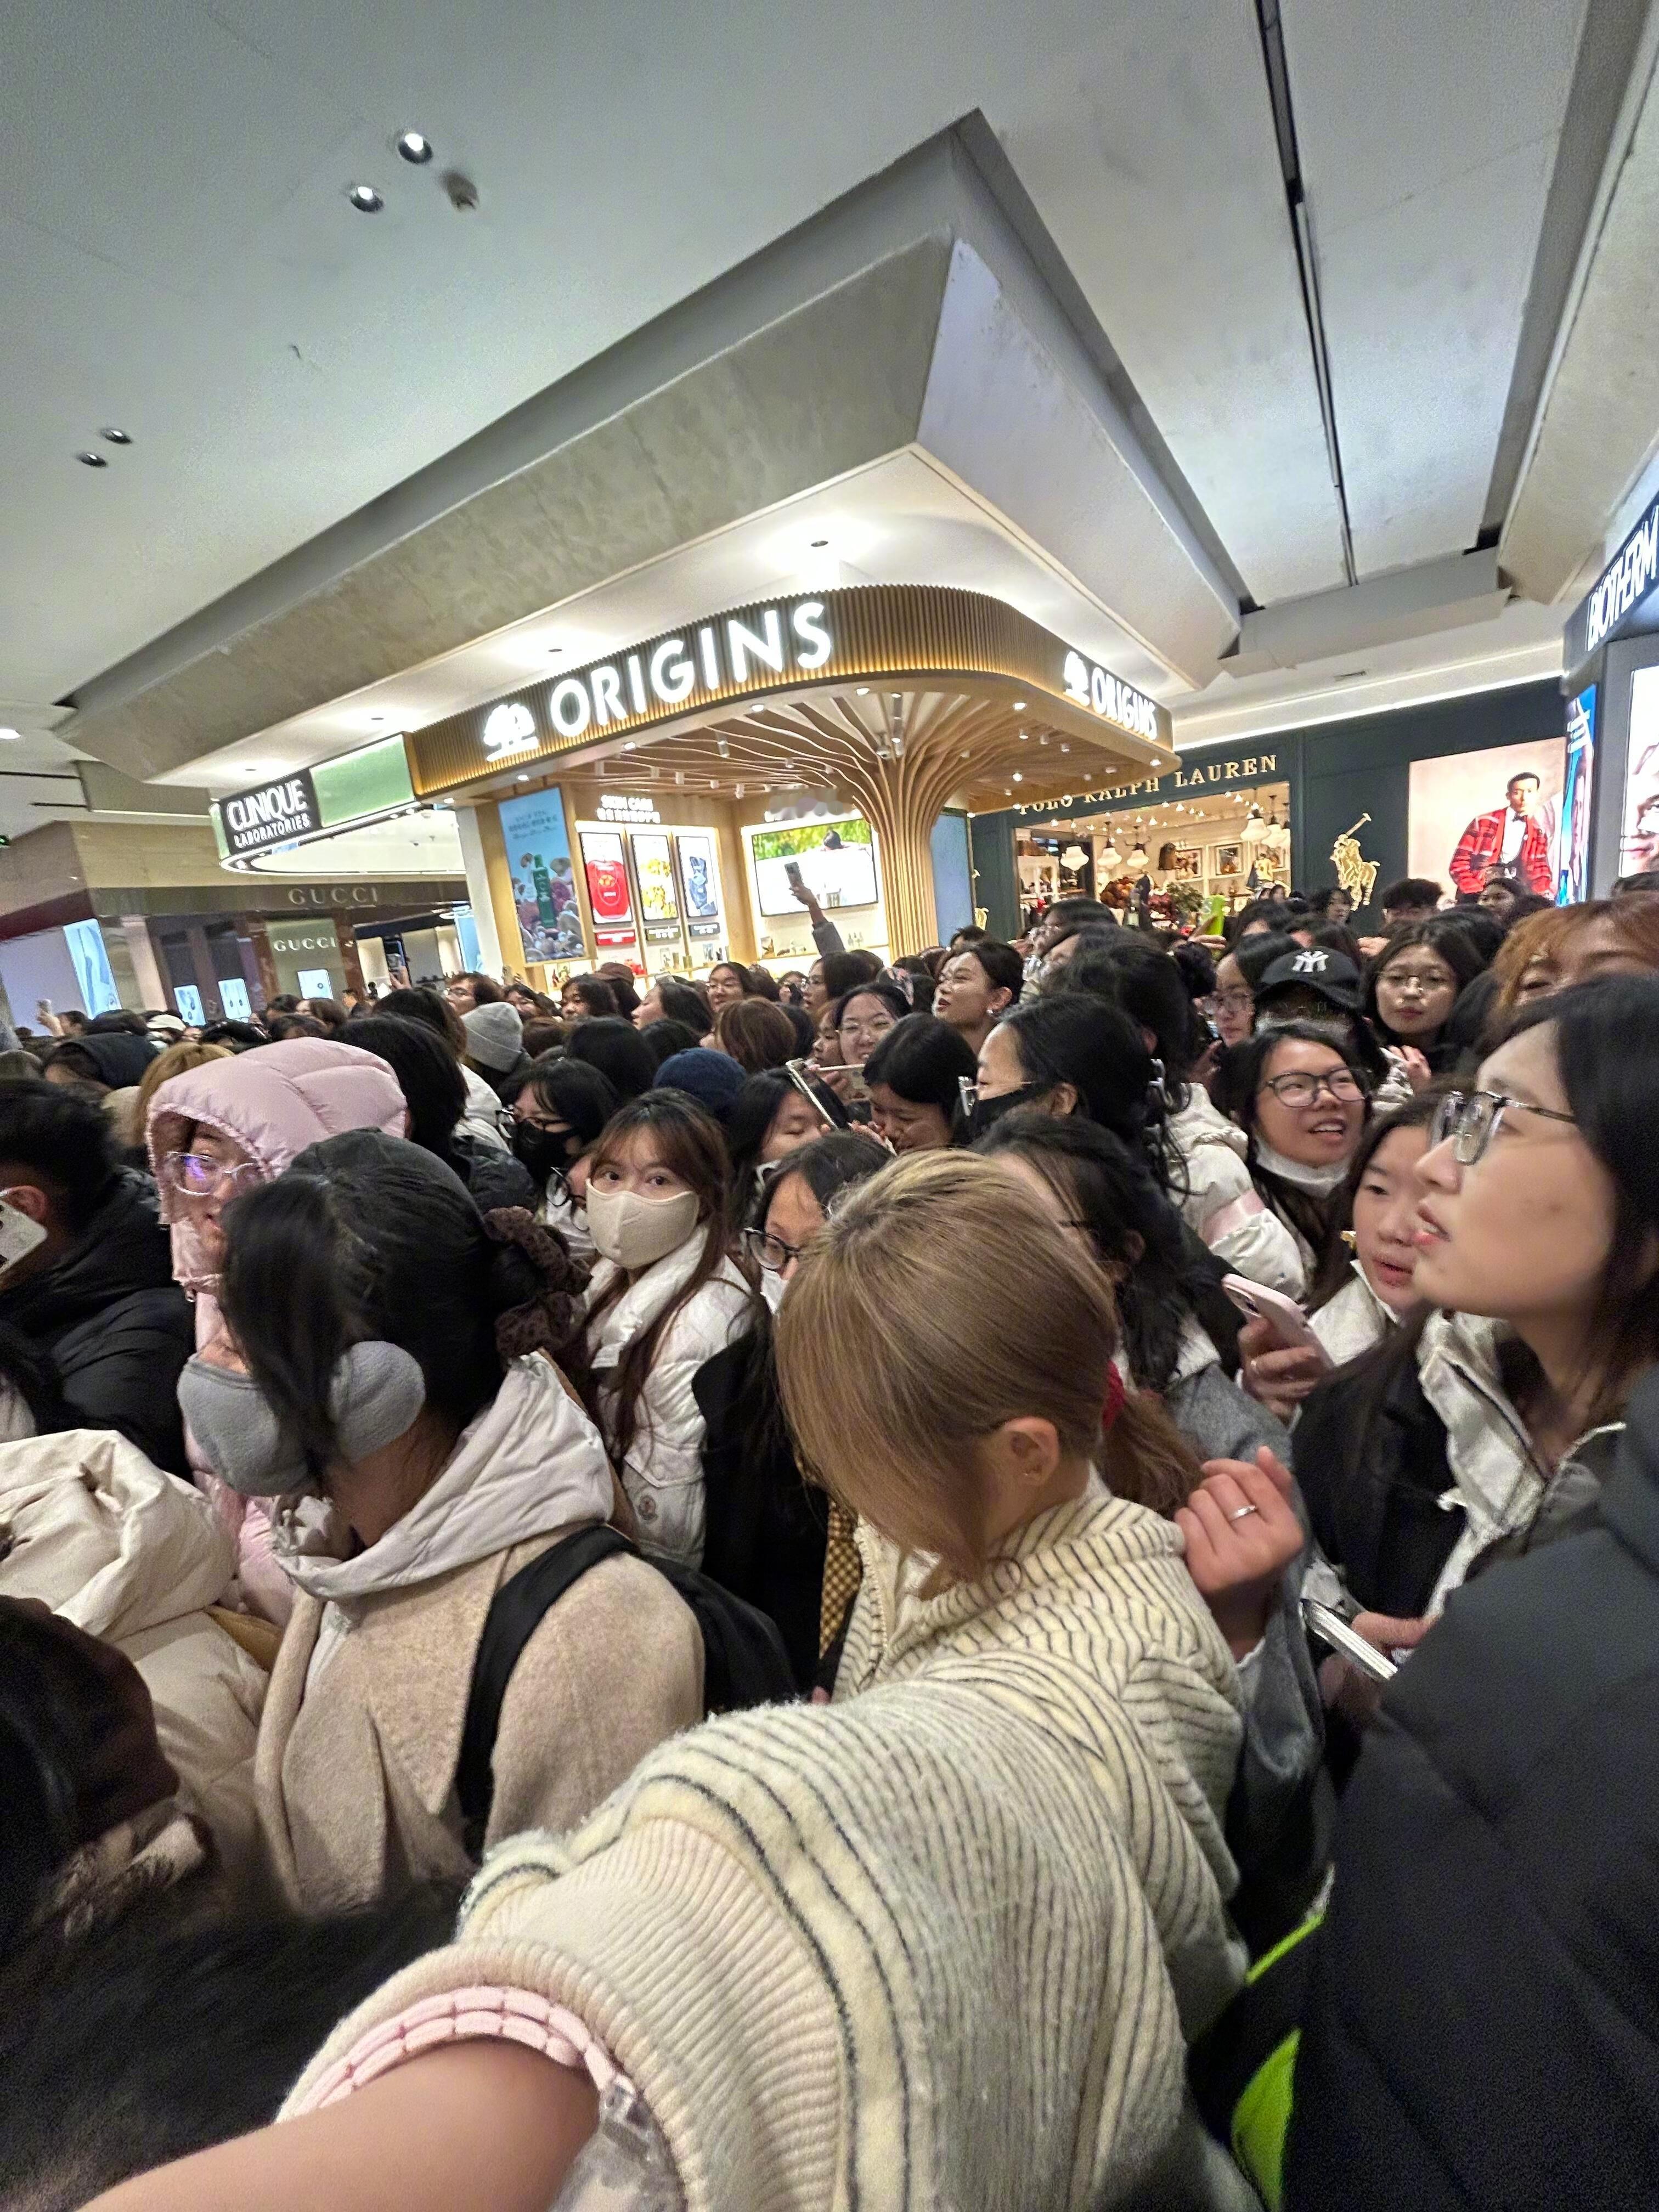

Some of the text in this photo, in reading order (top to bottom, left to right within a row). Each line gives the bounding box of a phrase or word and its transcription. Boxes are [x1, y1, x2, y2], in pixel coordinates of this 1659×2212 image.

[1585, 505, 1659, 652] BIOTHERM
[550, 602, 831, 738] ORIGINS
[1092, 667, 1158, 741] ORIGINS
[1175, 754, 1277, 788] LAUREN
[227, 779, 308, 831] CLINIQUE
[234, 812, 312, 849] LABORATORIES
[288, 886, 378, 905] GUCCI
[273, 936, 337, 952] GUCCI
